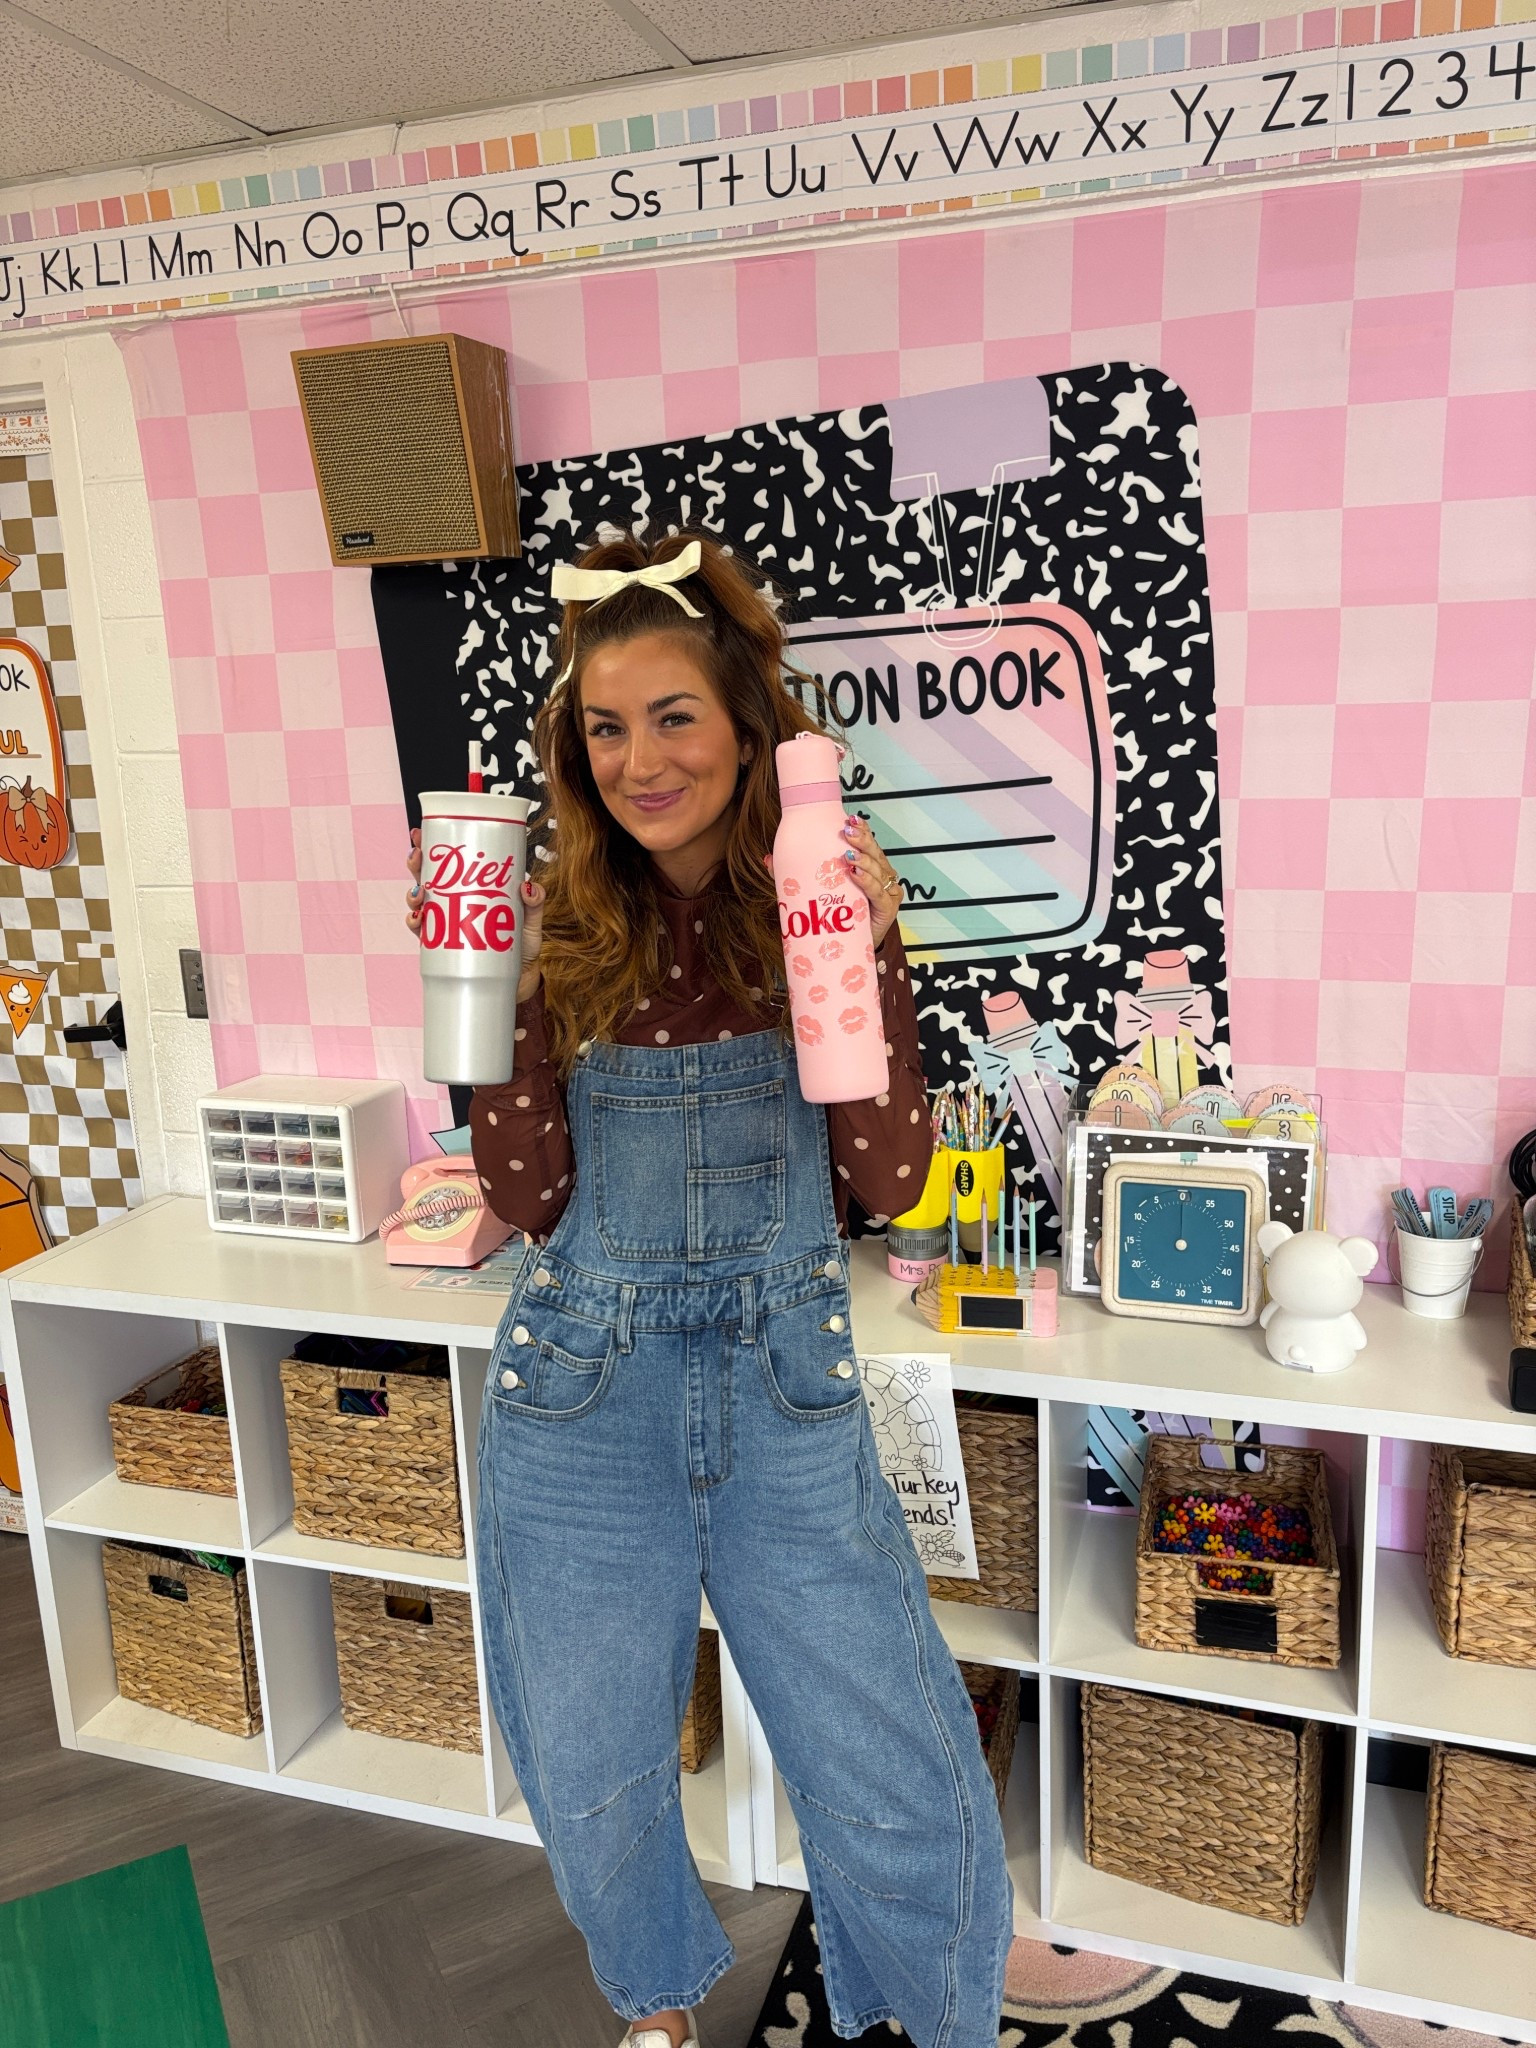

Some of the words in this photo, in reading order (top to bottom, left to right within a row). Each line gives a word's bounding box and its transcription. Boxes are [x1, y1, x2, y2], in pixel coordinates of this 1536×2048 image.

[0, 256, 26, 319] Jj
[40, 247, 84, 294] Kk
[93, 239, 128, 287] Ll
[148, 231, 213, 281] Mm
[234, 221, 286, 270] Nn
[302, 211, 363, 259] Oo
[376, 201, 430, 271] Pp
[447, 192, 529, 257] Qq
[535, 179, 590, 232] Rr
[610, 169, 662, 221] Ss
[678, 153, 744, 211] Tt
[765, 144, 826, 199] Uu
[851, 128, 919, 185] Vv
[932, 110, 1060, 174] Ww
[1082, 96, 1147, 157] Xx
[1170, 83, 1235, 167] Yy
[1261, 70, 1329, 133] Zz
[1377, 58, 1414, 118] 2
[1435, 50, 1469, 110] 3
[1488, 41, 1536, 101] 4
[916, 647, 1065, 720] BOOK
[425, 844, 514, 890] Diet
[818, 893, 846, 906] Diet
[420, 892, 515, 953] oke
[1276, 1119, 1292, 1142] 3
[960, 1160, 969, 1196] SHARP
[1153, 1196, 1160, 1204] 5
[1180, 1192, 1186, 1201] 0
[1205, 1199, 1216, 1208] 55
[1441, 1196, 1456, 1225] SIT-UP
[1133, 1212, 1143, 1220] 10
[1224, 1220, 1234, 1228] 50
[1126, 1236, 1135, 1244] 15
[1229, 1245, 1240, 1253] 45
[1131, 1260, 1141, 1268] 20
[900, 1262, 926, 1276] Mrs.
[1221, 1268, 1232, 1276] 40
[1150, 1280, 1161, 1289] 25
[1175, 1289, 1186, 1297] 30
[1201, 1285, 1212, 1294] 35
[886, 1470, 960, 1506] Turkey
